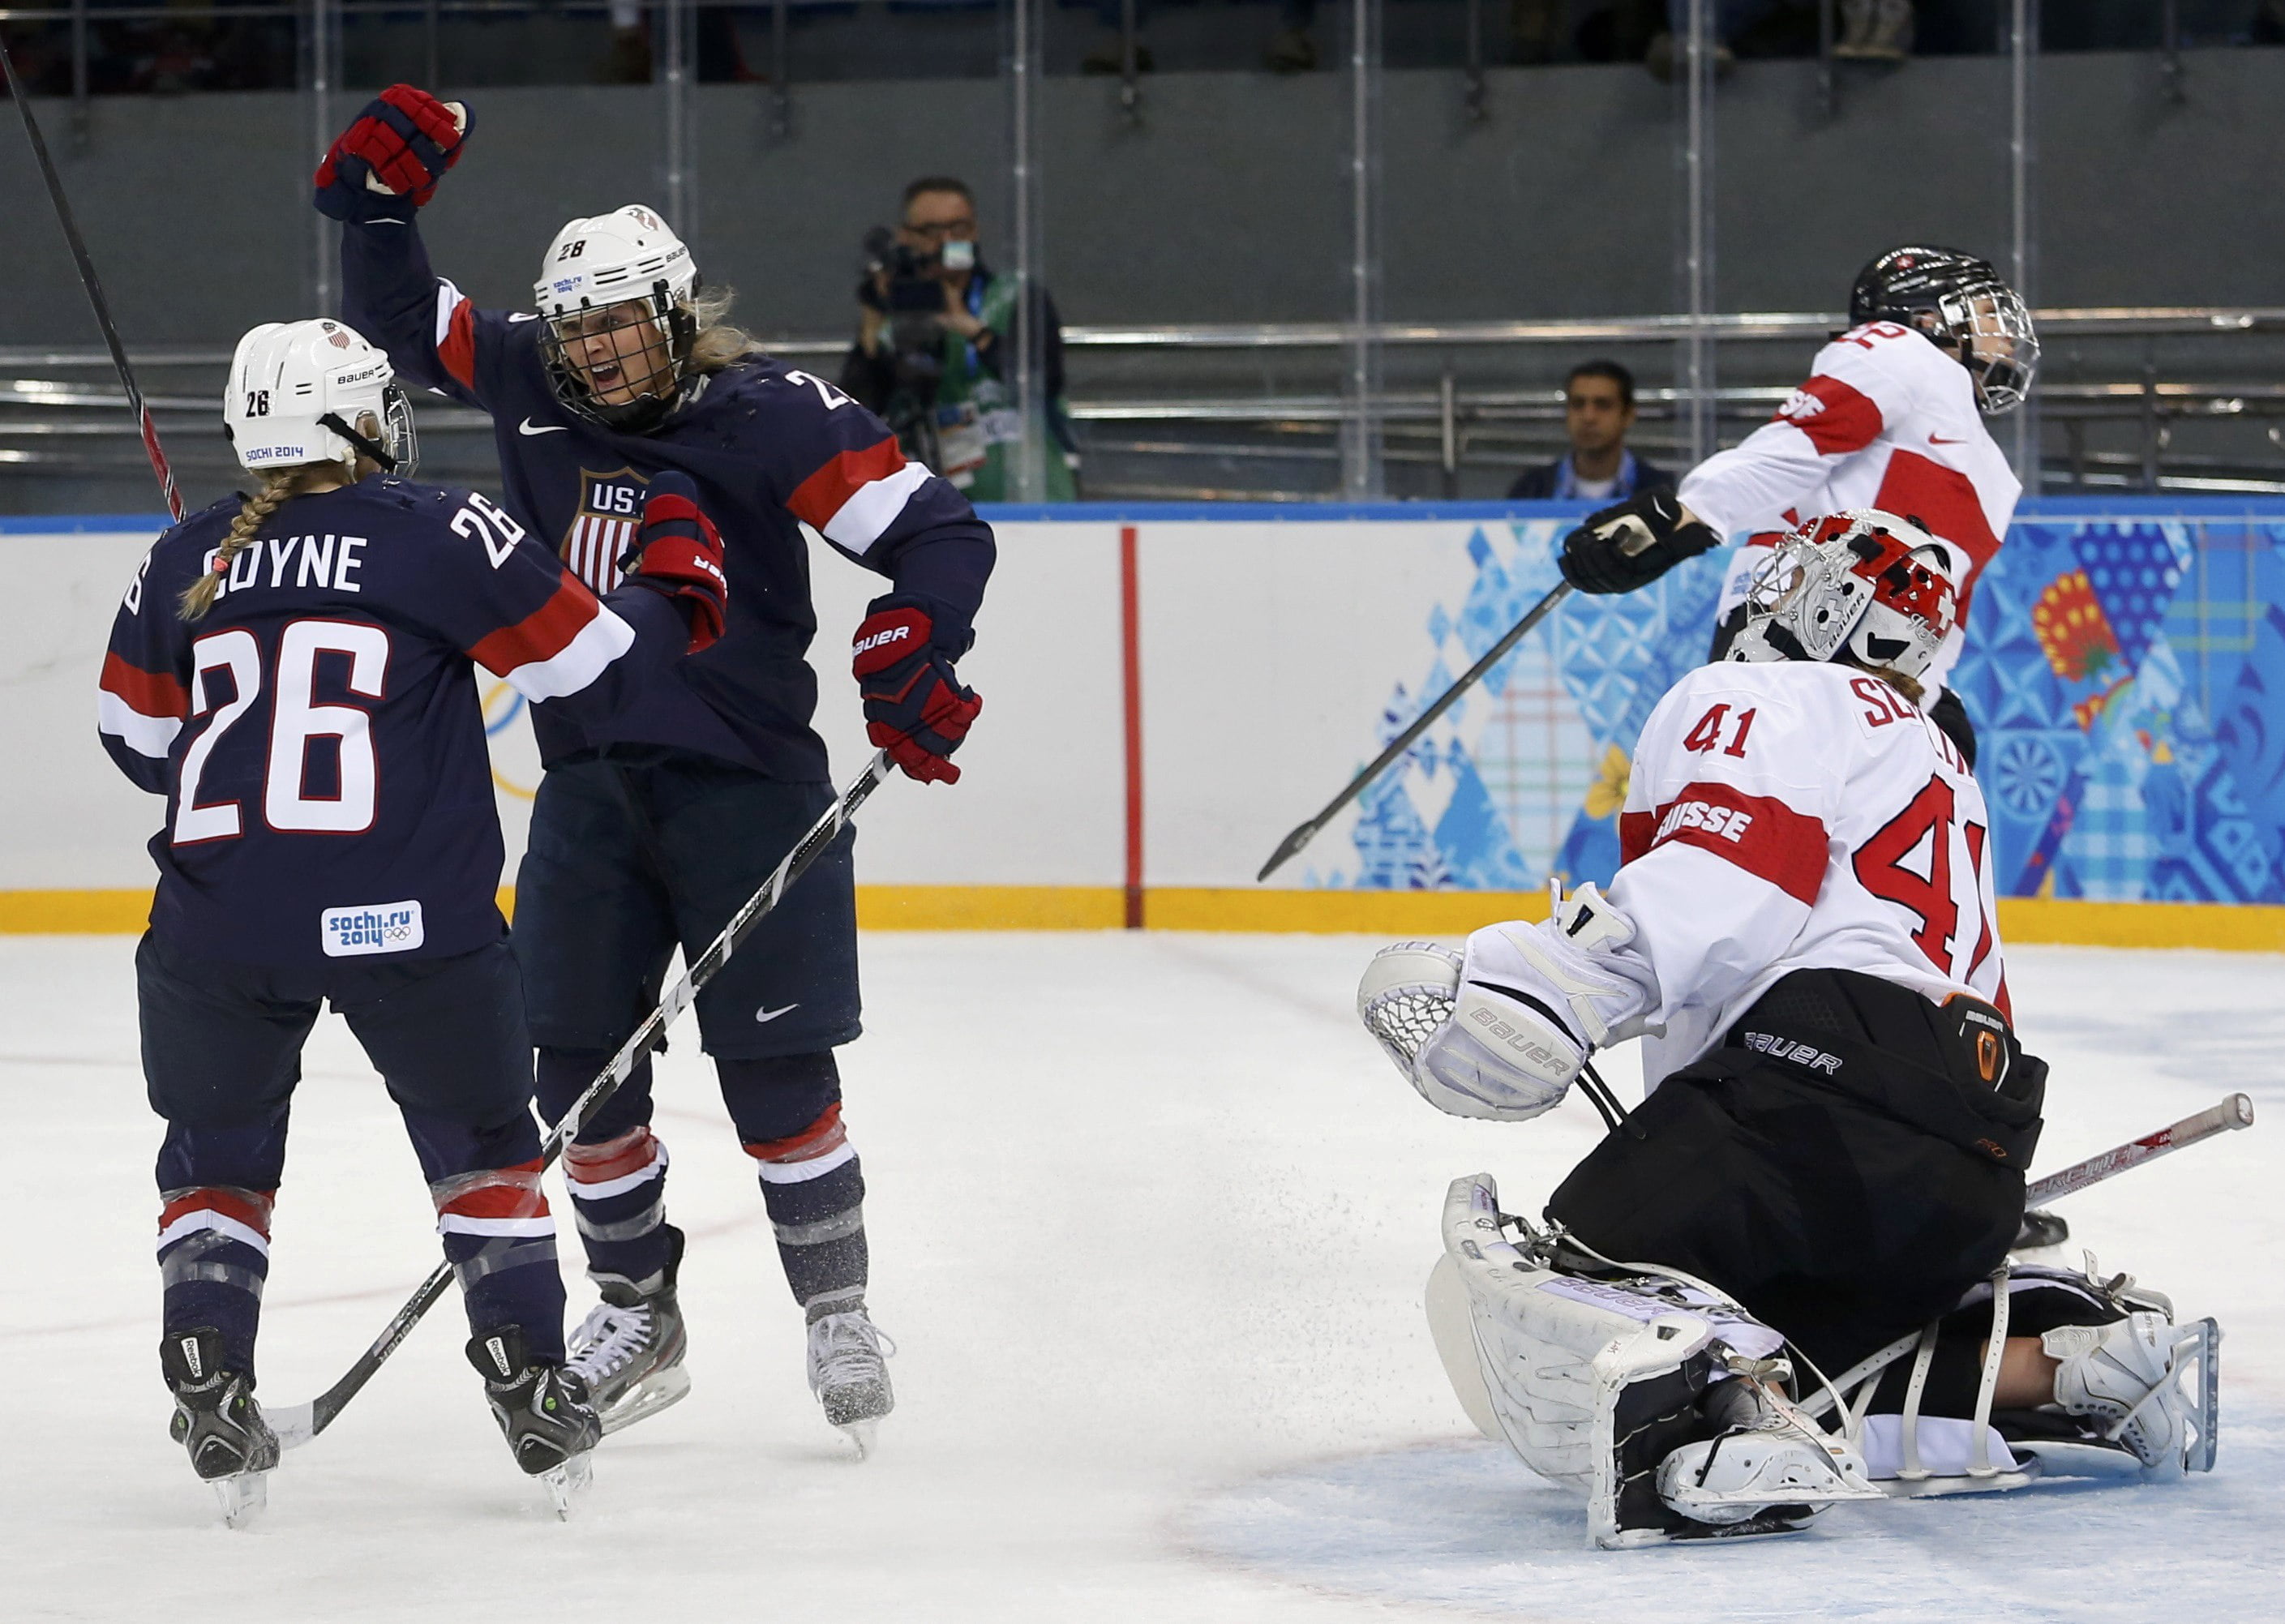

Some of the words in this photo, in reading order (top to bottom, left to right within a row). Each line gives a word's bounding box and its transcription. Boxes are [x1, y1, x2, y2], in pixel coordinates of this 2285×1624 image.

[558, 240, 586, 262] 28
[246, 390, 270, 418] 26
[246, 448, 272, 461] SOCHI
[276, 447, 303, 456] 2014
[593, 484, 646, 514] US
[450, 492, 525, 569] 26
[852, 626, 909, 657] AUER
[173, 618, 391, 846] 26
[1683, 703, 1756, 759] 41
[1851, 770, 1991, 983] 41
[330, 911, 409, 931] sochi.ru
[341, 929, 384, 947] 2014
[185, 1340, 202, 1376] Reebok
[490, 1339, 510, 1374] Reebok
